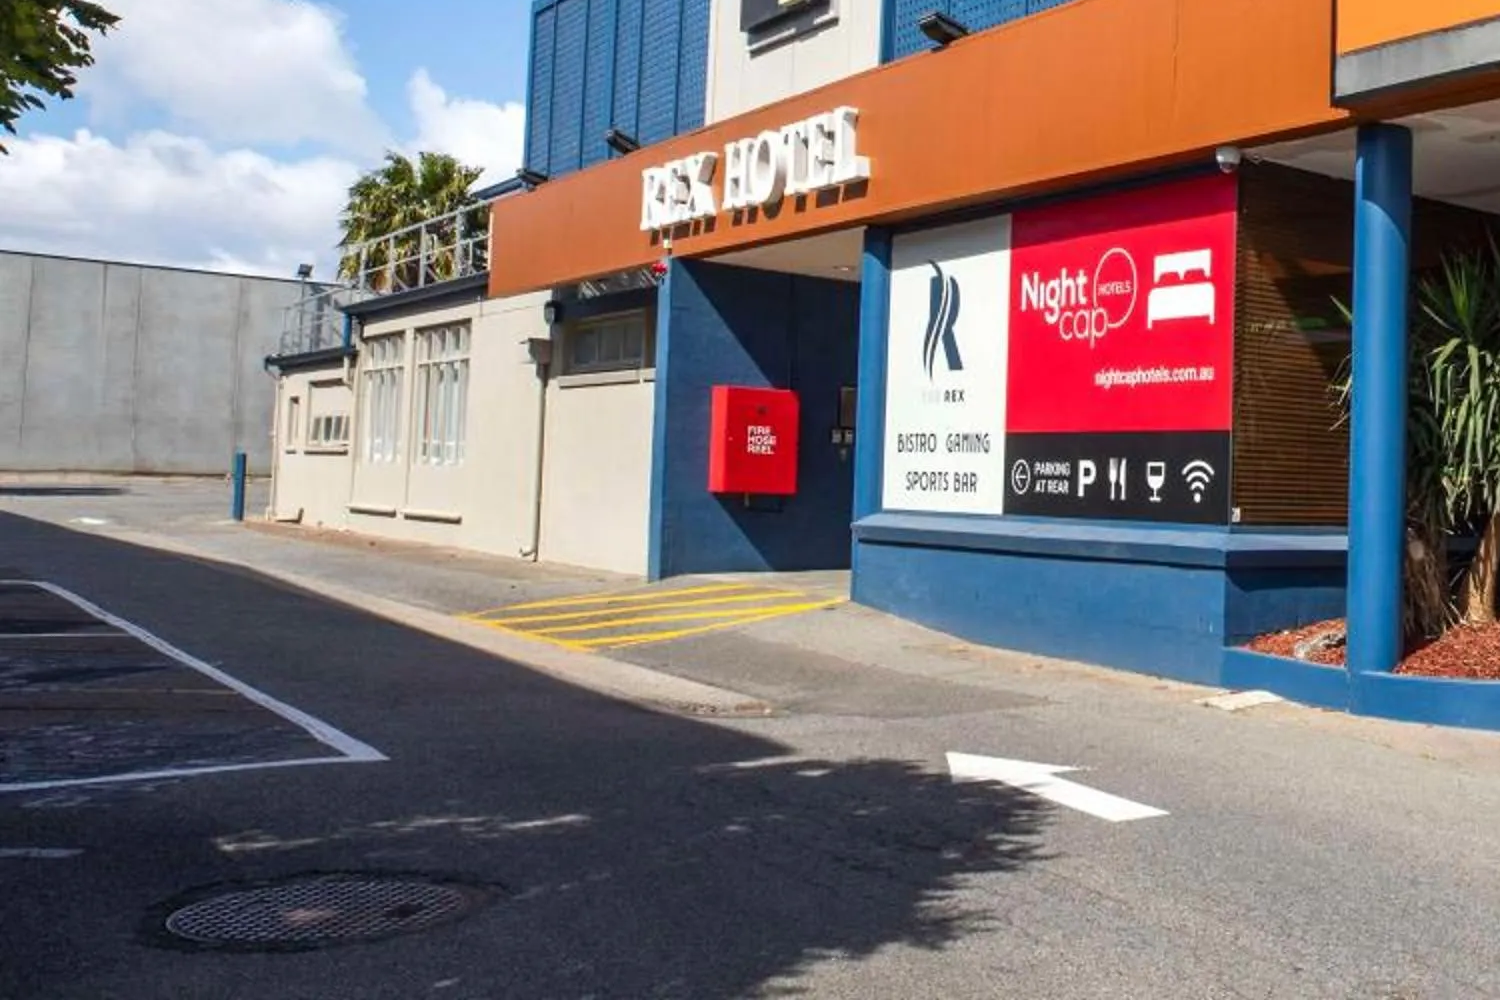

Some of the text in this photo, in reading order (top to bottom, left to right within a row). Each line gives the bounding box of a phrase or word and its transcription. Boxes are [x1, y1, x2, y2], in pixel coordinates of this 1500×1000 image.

[640, 106, 871, 231] REX HOTEL
[1020, 267, 1089, 325] Night
[1098, 281, 1132, 297] HOTELS
[1059, 307, 1109, 349] cap
[1094, 365, 1215, 389] nightcaphotels.com.au
[943, 389, 965, 403] REX
[897, 432, 991, 454] BISTRO GAMING
[1033, 461, 1072, 476] PARKING
[905, 471, 979, 493] SPORTS BAR
[1035, 480, 1070, 494] AT REAR
